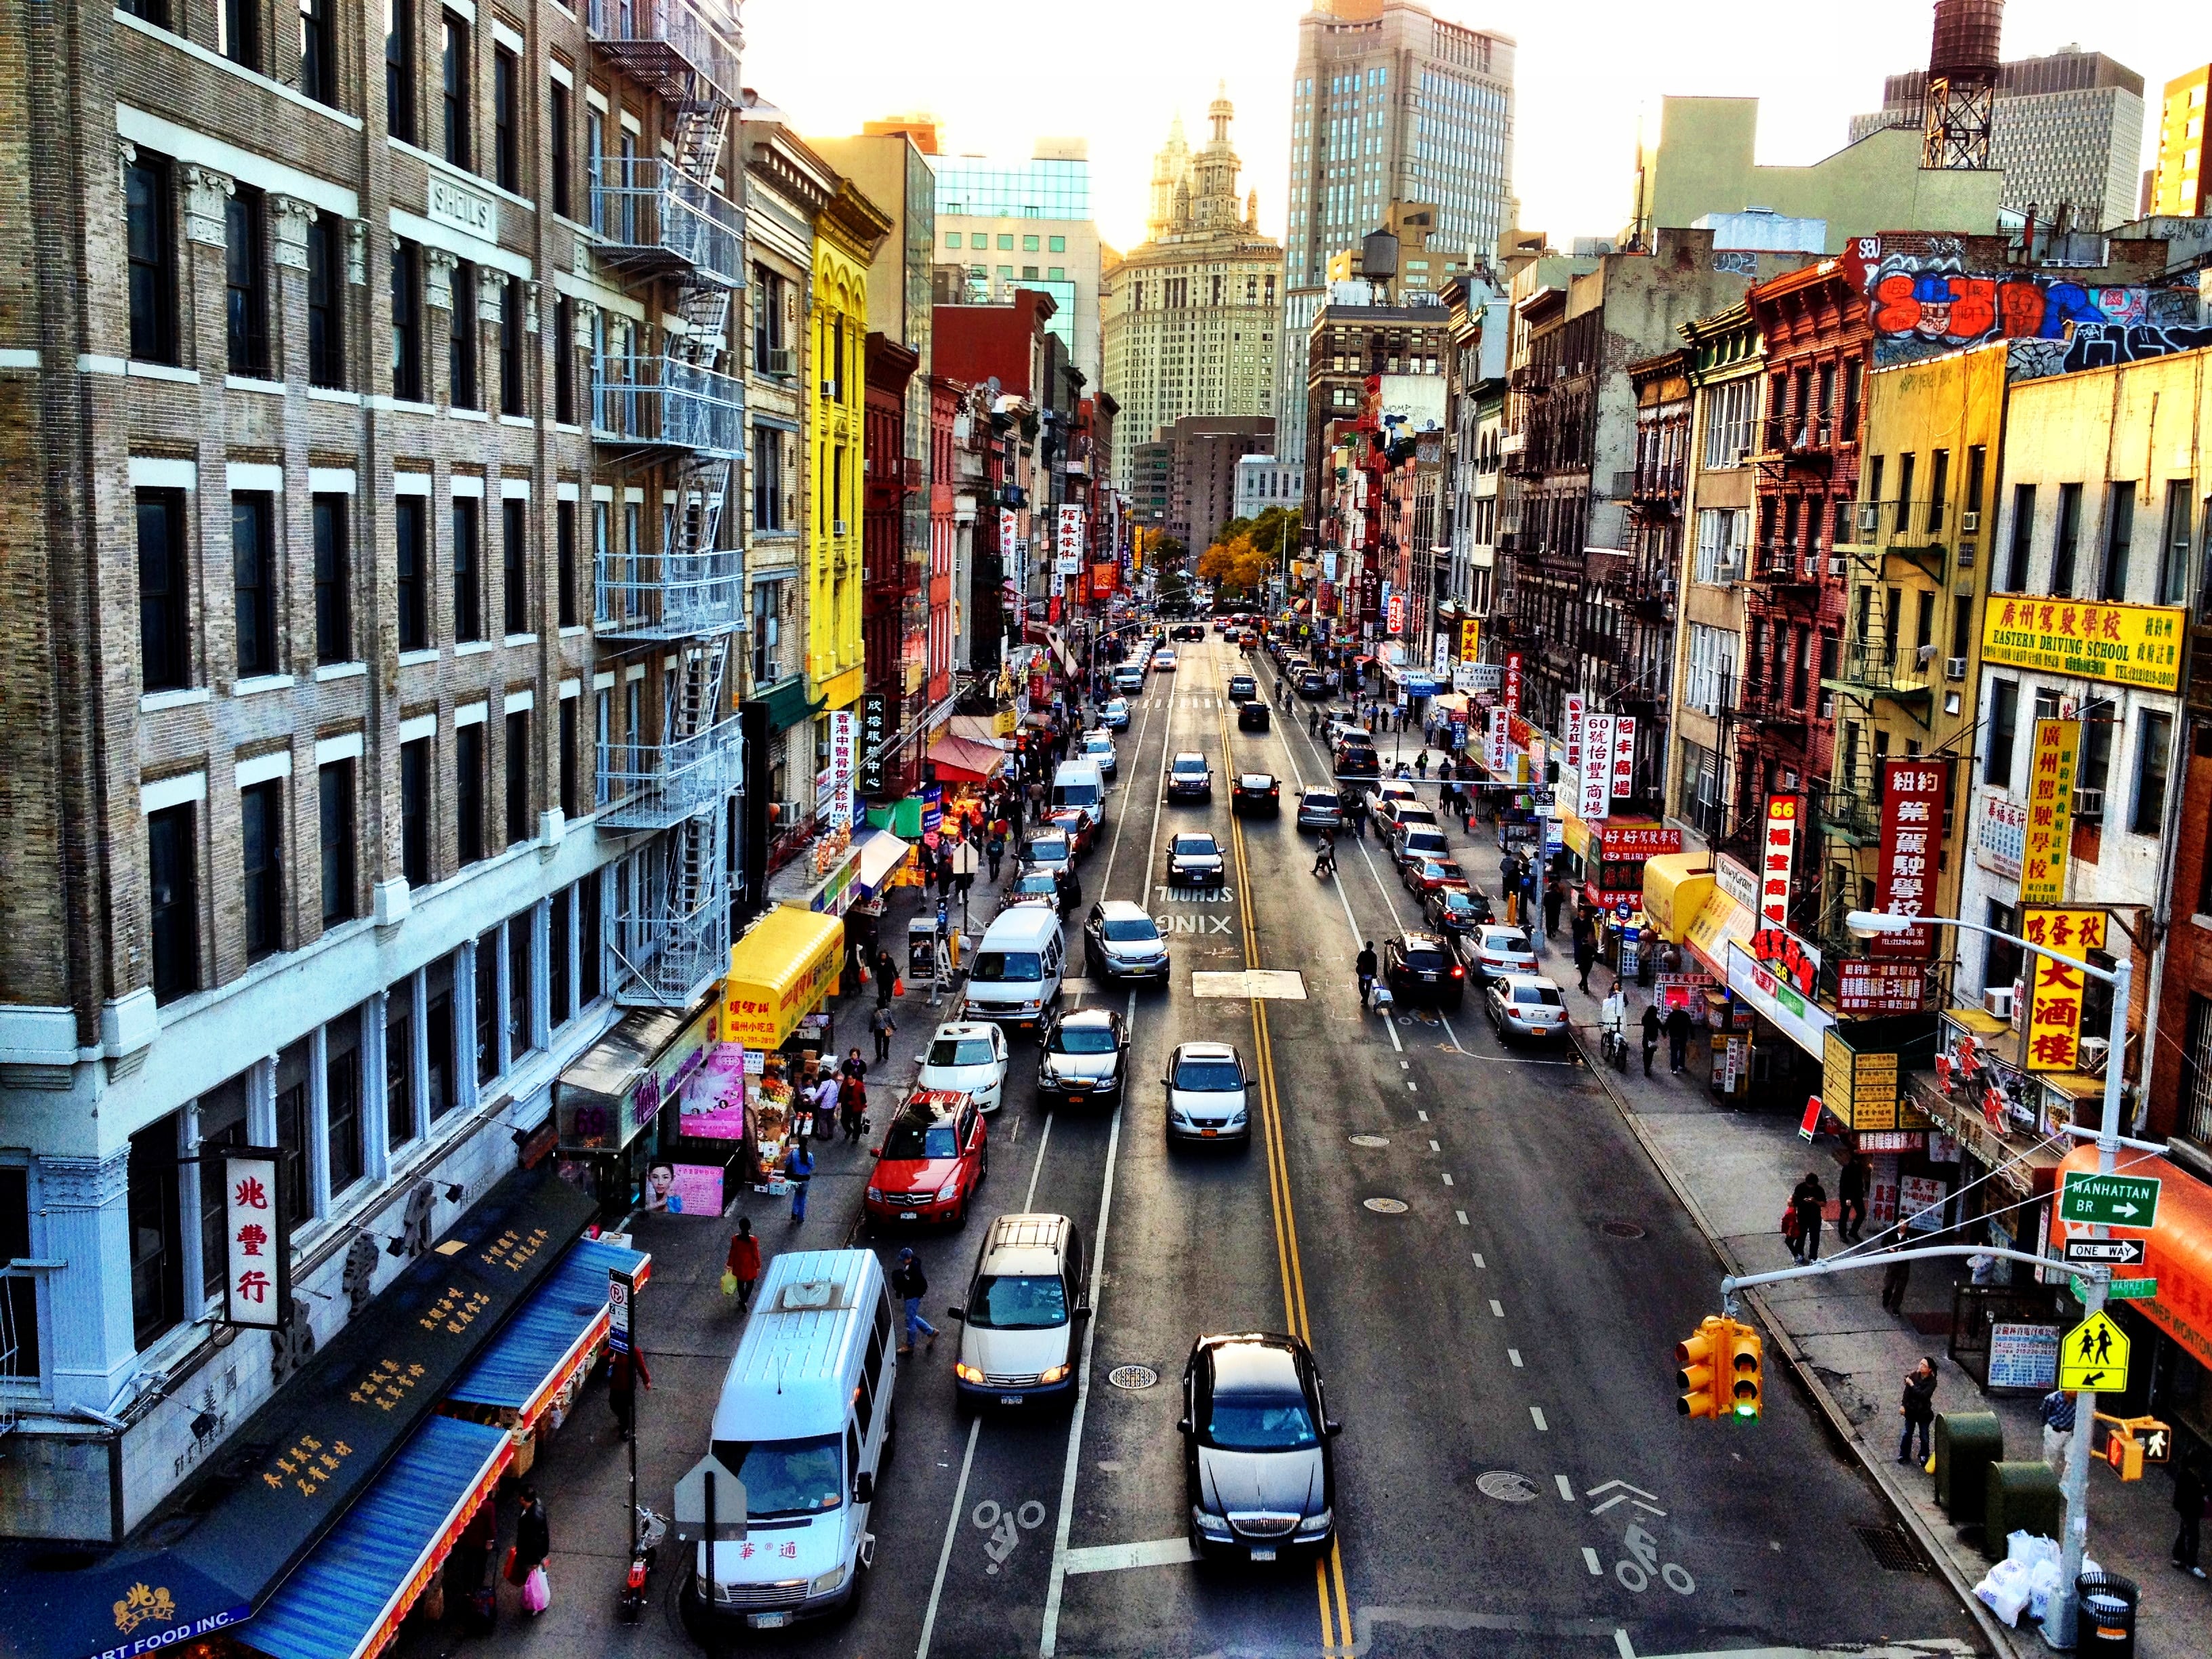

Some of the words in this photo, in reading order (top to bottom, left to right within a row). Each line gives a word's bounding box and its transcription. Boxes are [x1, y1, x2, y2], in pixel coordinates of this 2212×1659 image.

[2000, 601, 2121, 641] 廣州駕駛學校
[1993, 629, 2036, 648] EASTERN
[2040, 636, 2083, 655] DRIVING
[2087, 641, 2129, 661] SCHOOL
[1893, 771, 1938, 792] 紐約
[1770, 802, 1795, 817] 66
[2028, 726, 2062, 879] 廣州駕駛學校
[1155, 915, 1233, 934] XING
[2027, 915, 2101, 947] 鴨蛋秋
[1775, 962, 1788, 982] 66
[2031, 959, 2083, 1066] 大酒樓
[731, 1021, 775, 1033] 福州小吃店
[2072, 1181, 2150, 1200] MANHATTAN
[235, 1176, 270, 1304] 兆豐行
[2076, 1246, 2098, 1256] ONE
[2108, 1247, 2132, 1256] WAY
[135, 1625, 190, 1654] FOOD
[197, 1612, 234, 1633] INC.
